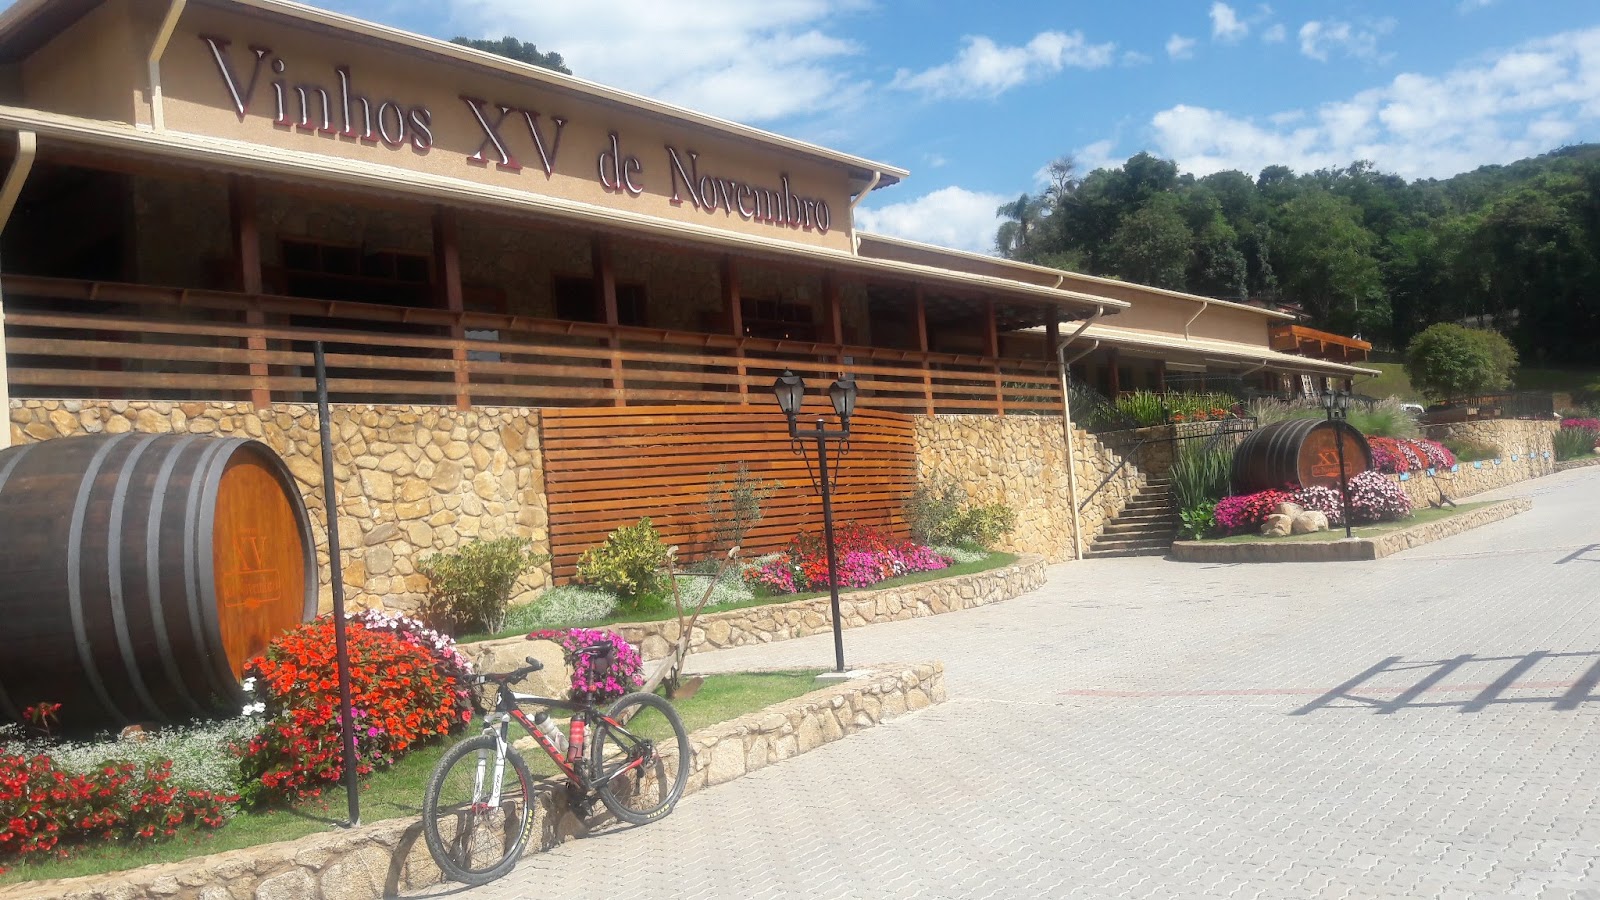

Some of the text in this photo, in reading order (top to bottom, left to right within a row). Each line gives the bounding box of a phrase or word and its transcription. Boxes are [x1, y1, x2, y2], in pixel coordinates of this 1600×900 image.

[199, 34, 831, 234] Vinhos XV de Novembro
